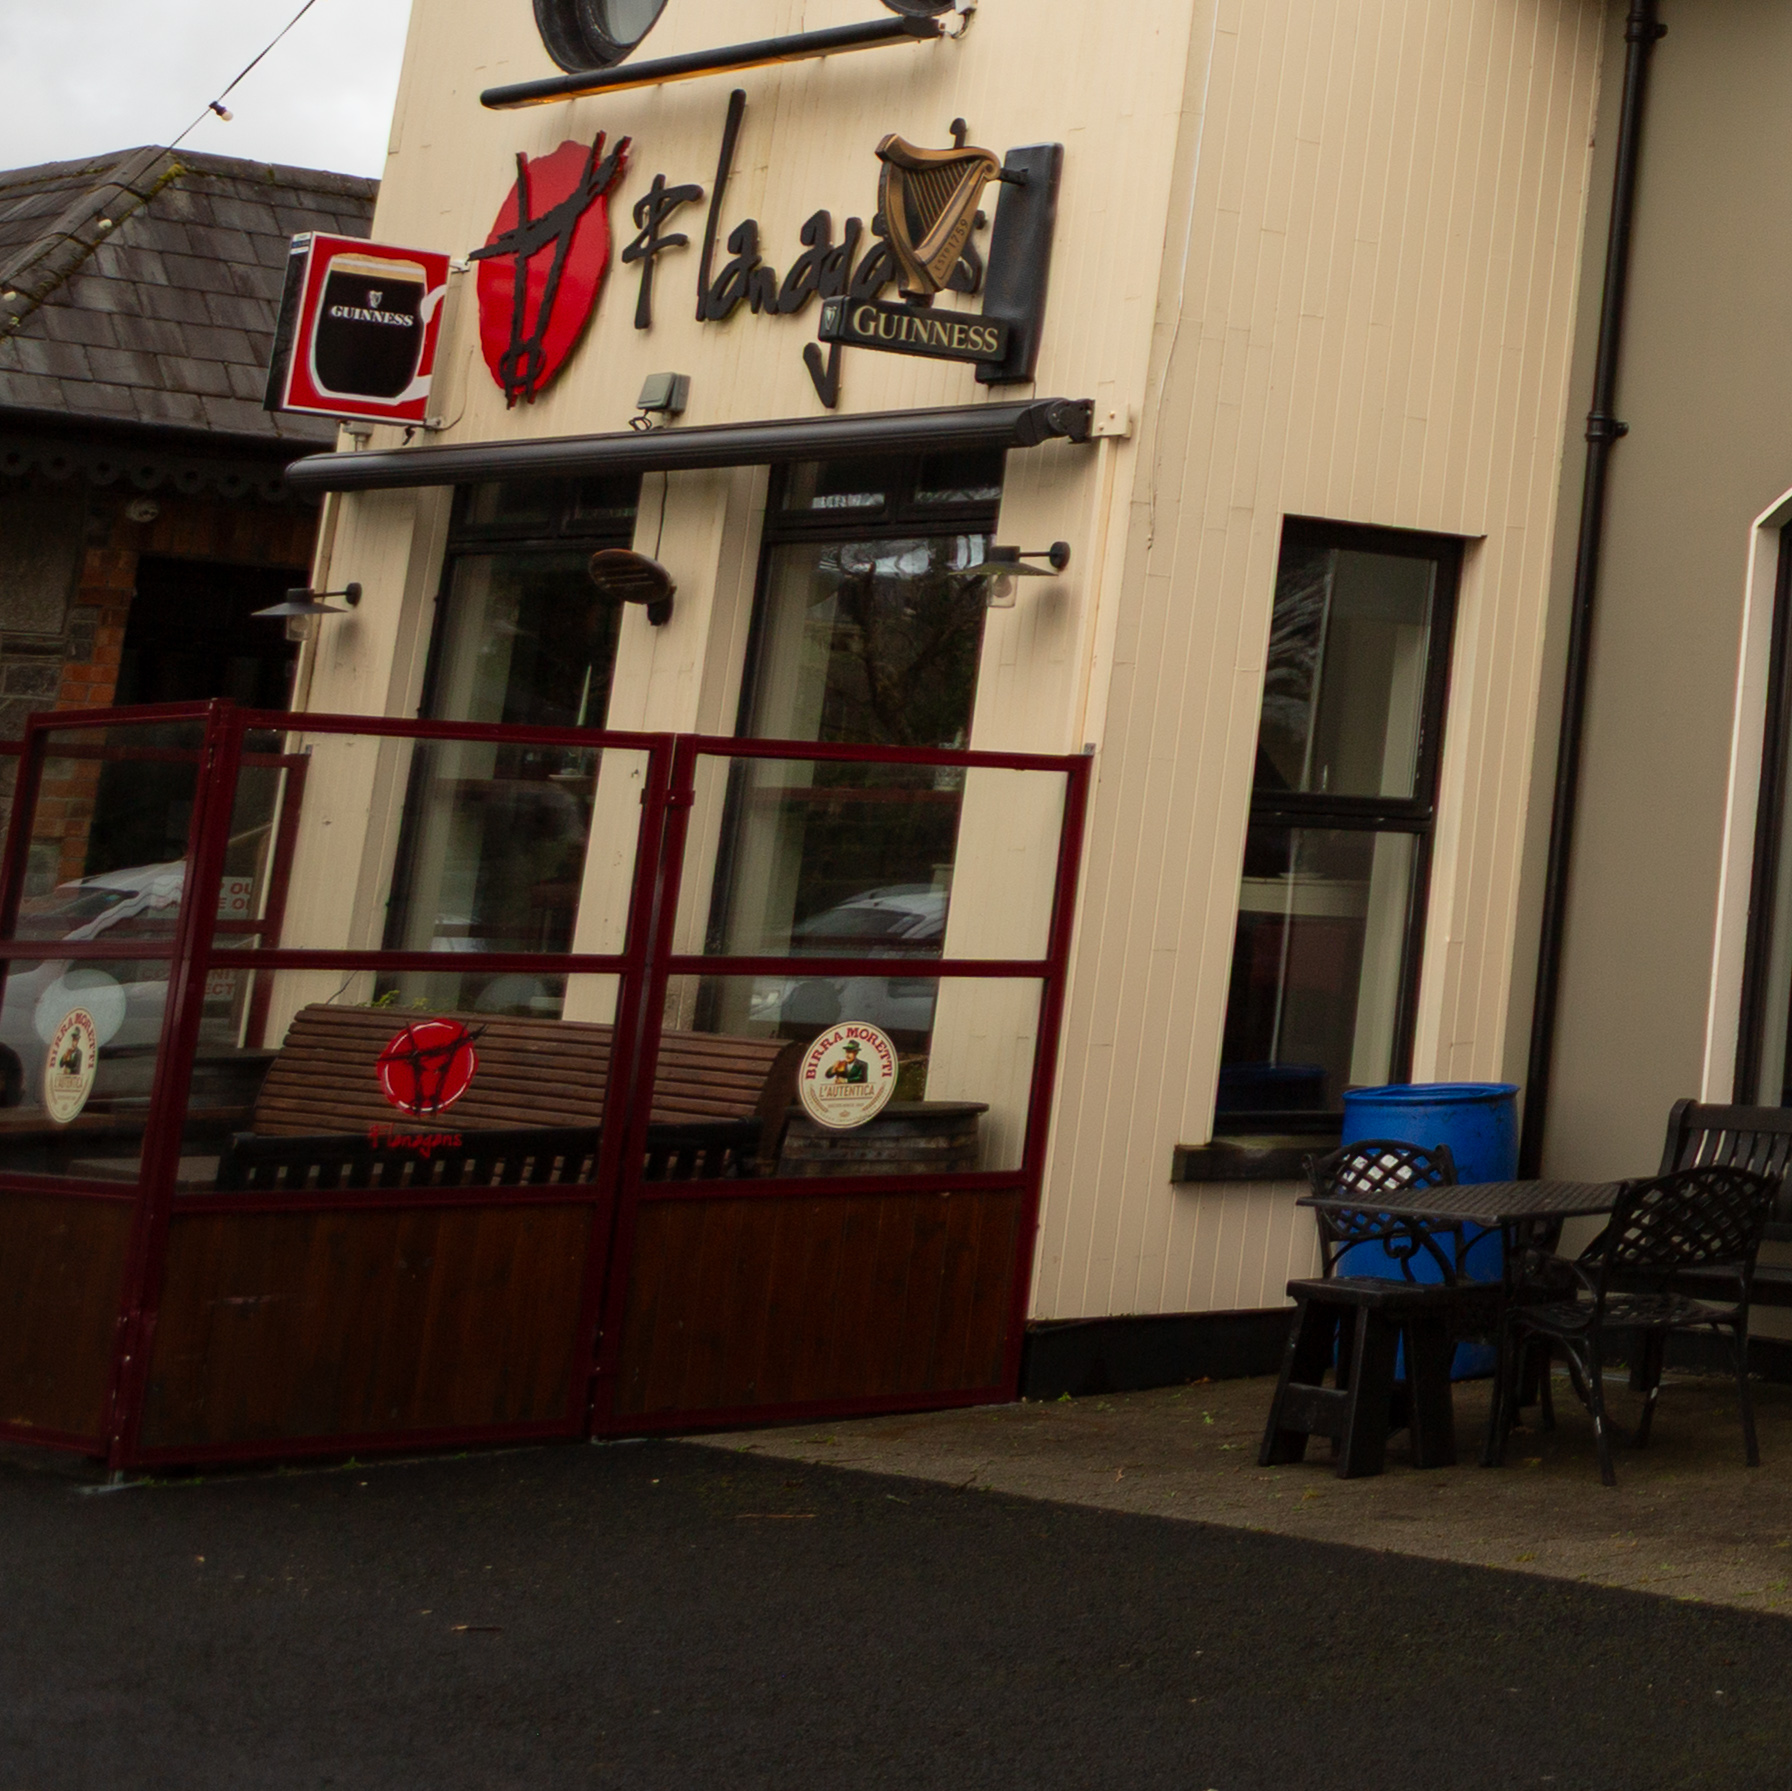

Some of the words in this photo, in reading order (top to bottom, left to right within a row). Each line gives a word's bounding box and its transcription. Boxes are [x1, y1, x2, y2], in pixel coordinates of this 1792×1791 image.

[948, 218, 968, 249] 1759
[331, 304, 415, 328] GUINNESS
[852, 304, 999, 353] GUINNESS
[805, 1031, 844, 1080] BIRRA
[846, 1027, 893, 1078] MORETTI
[819, 1084, 875, 1098] L'AUTENTICA
